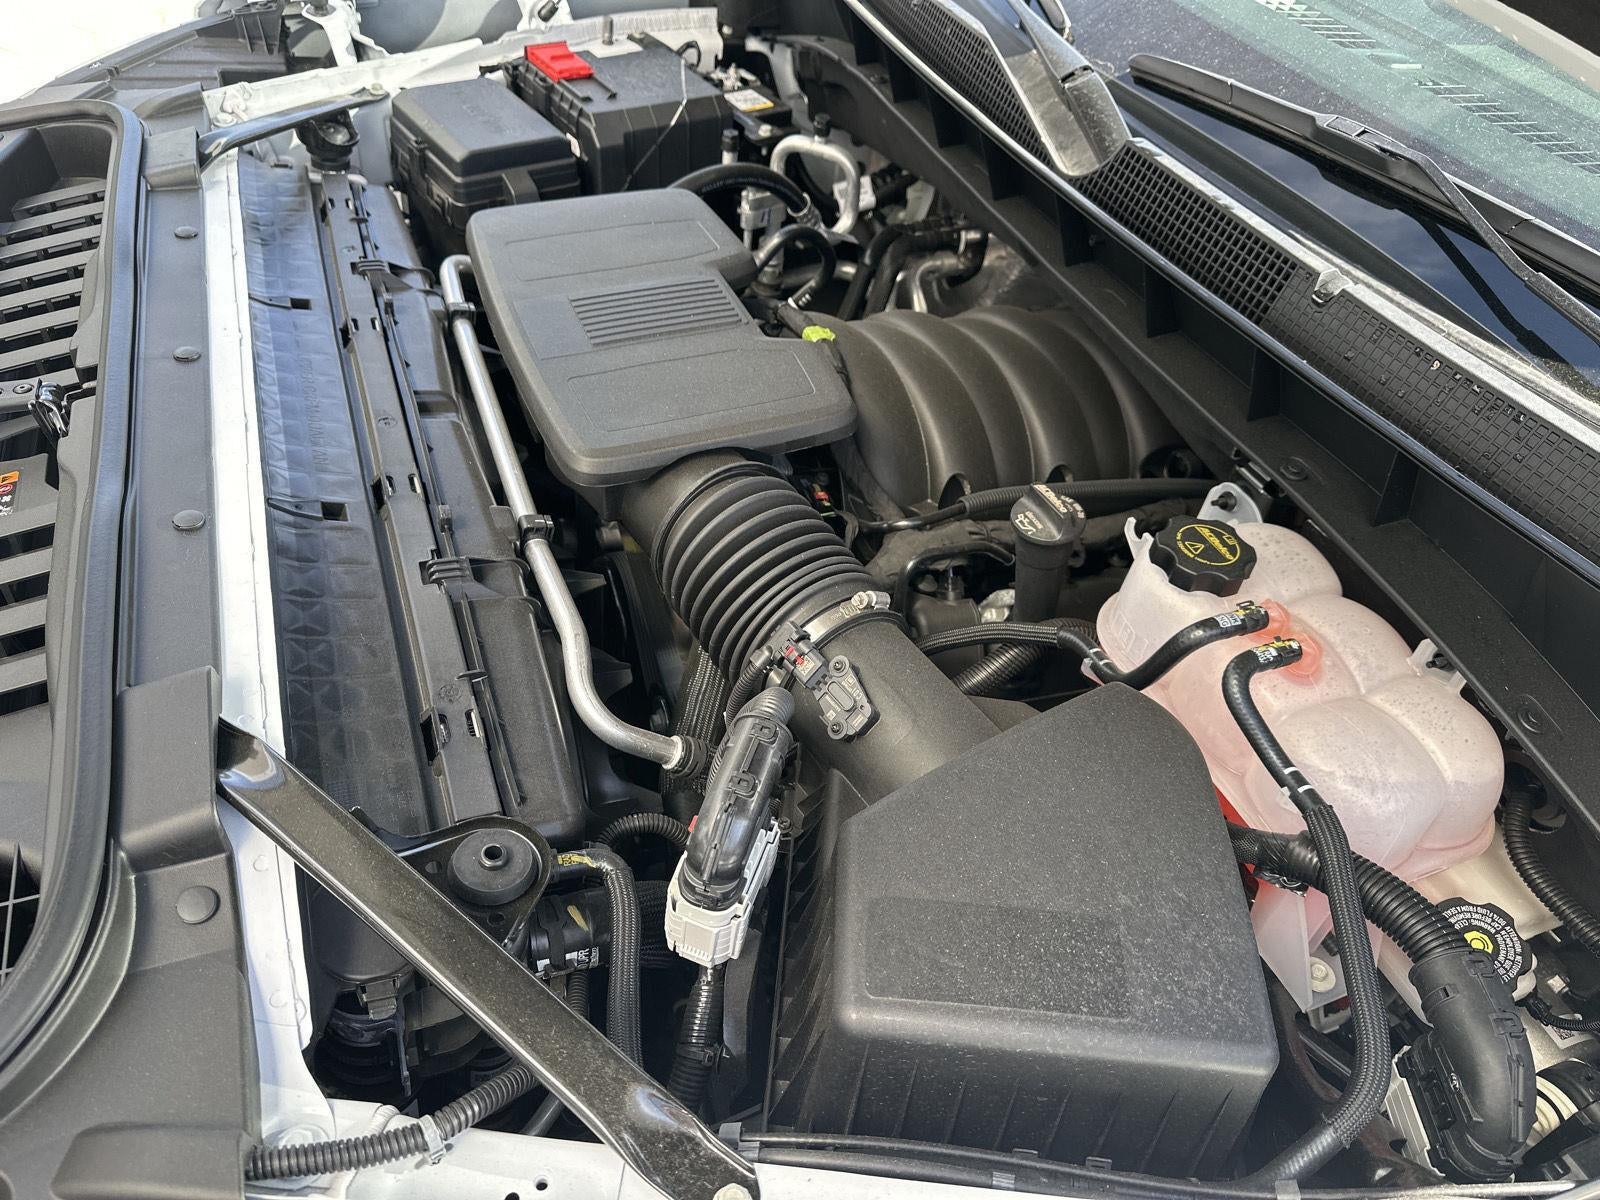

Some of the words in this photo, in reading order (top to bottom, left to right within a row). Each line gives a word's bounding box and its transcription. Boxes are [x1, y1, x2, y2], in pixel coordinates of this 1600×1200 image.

[1198, 527, 1234, 561] ACDelco
[1448, 912, 1472, 924] REMOVIN
[1477, 906, 1494, 918] FLUID
[1471, 912, 1492, 925] BEFORE
[1492, 914, 1507, 926] DOT4
[1491, 921, 1502, 930] CAP
